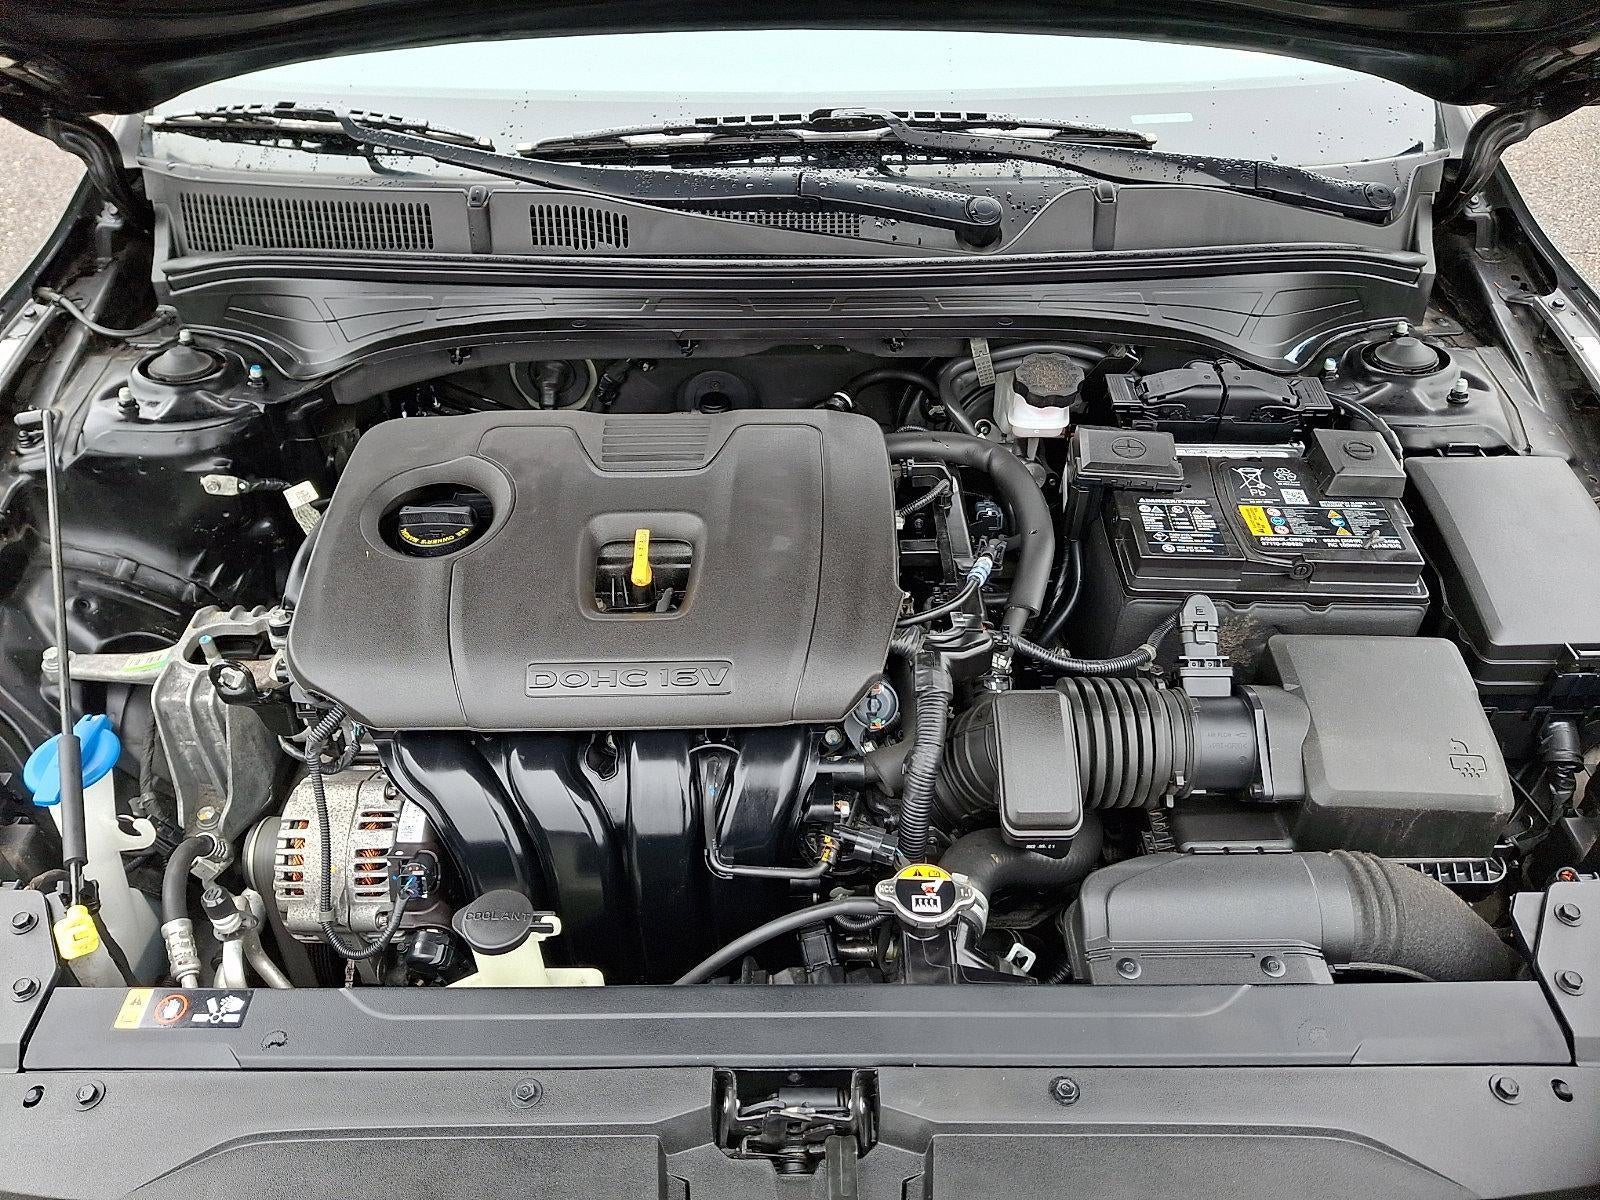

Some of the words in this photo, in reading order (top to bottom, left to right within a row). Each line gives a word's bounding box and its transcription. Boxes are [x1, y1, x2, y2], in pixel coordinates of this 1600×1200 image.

[1250, 488, 1267, 497] Pb
[529, 669, 648, 689] DOHC
[660, 667, 729, 687] 16V
[465, 910, 532, 922] COOLANT
